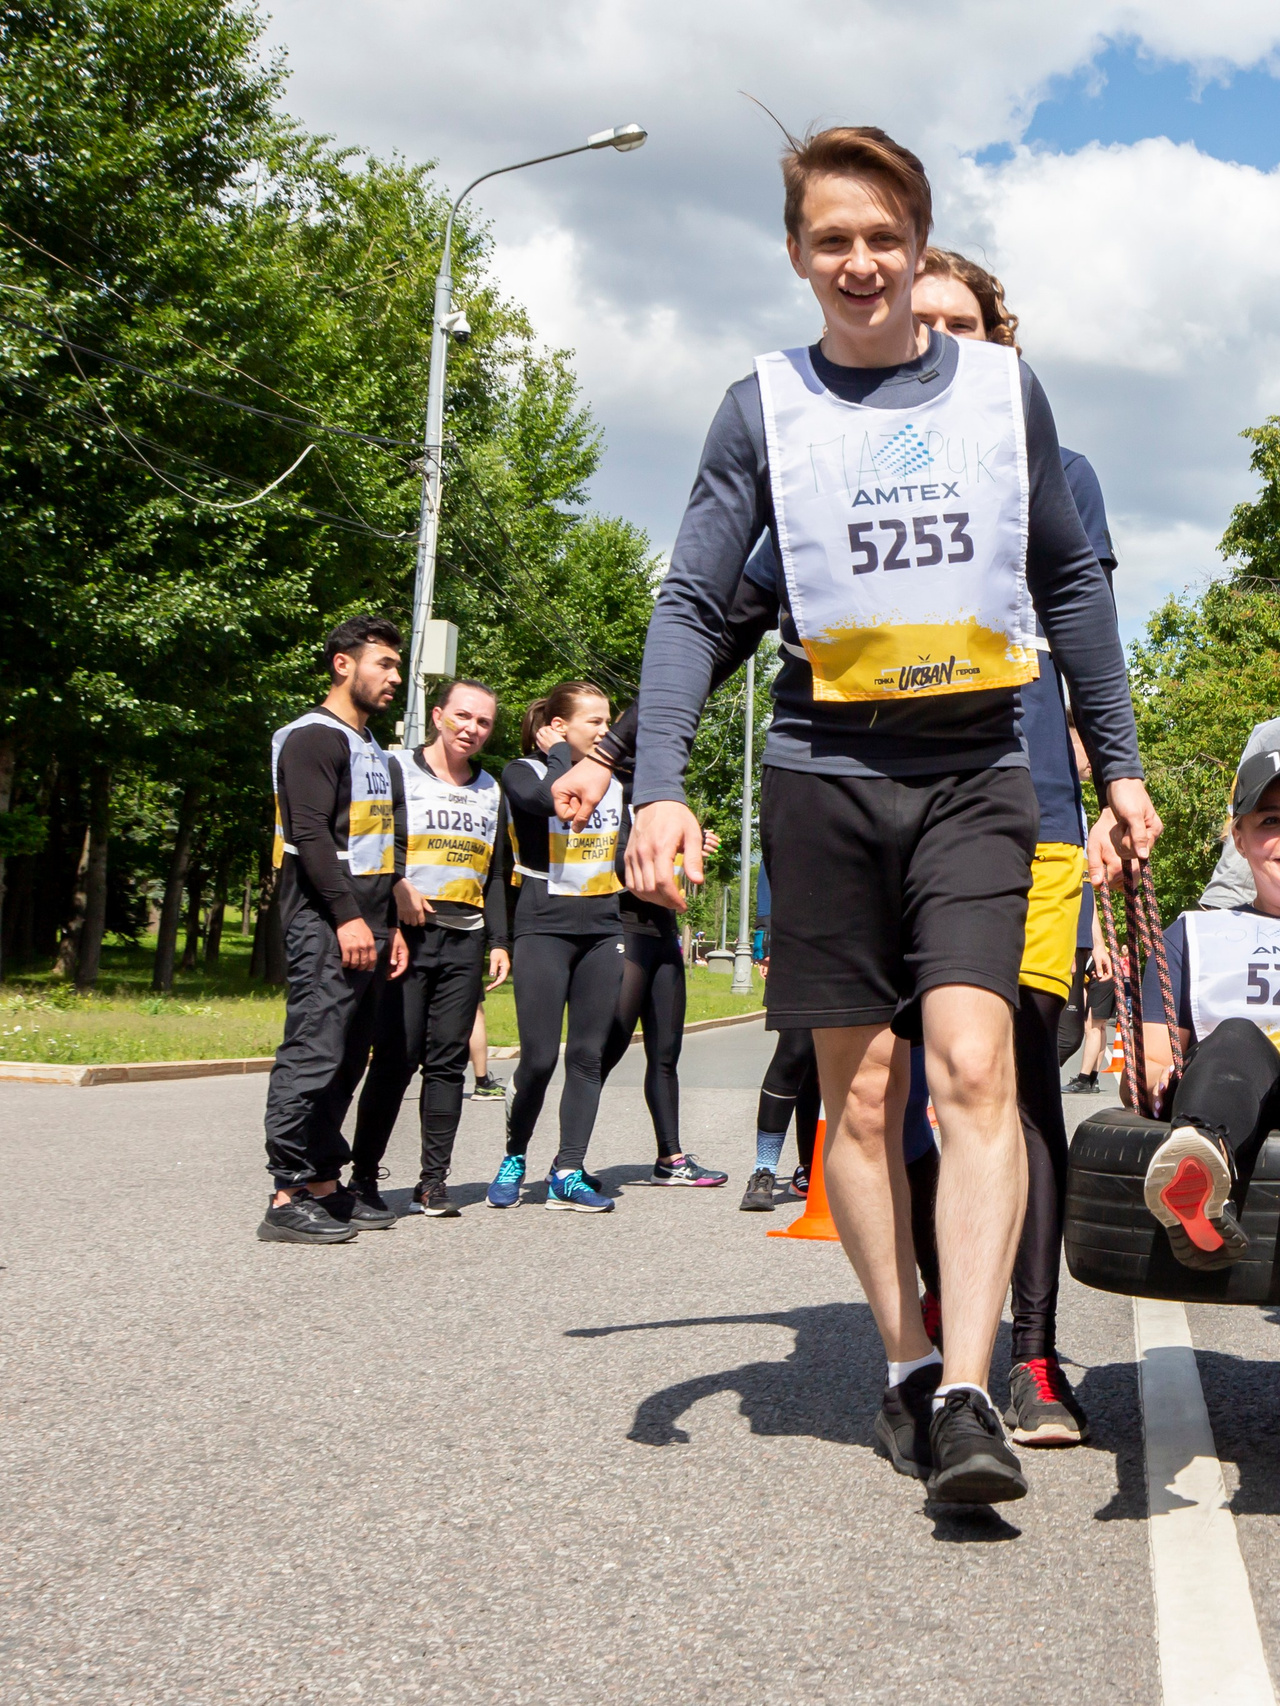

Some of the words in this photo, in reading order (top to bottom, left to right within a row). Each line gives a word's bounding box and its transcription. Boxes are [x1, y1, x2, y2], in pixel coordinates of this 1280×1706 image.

[851, 481, 961, 508] AMTEX
[847, 512, 974, 575] 5253
[899, 655, 955, 691] URBAN
[425, 809, 489, 836] 1028-5
[427, 839, 486, 856] КОМАНДНЫЙ
[566, 835, 618, 848] КОМАНДНЫ
[446, 851, 474, 864] СТАРТ
[581, 848, 610, 860] СТАРТ
